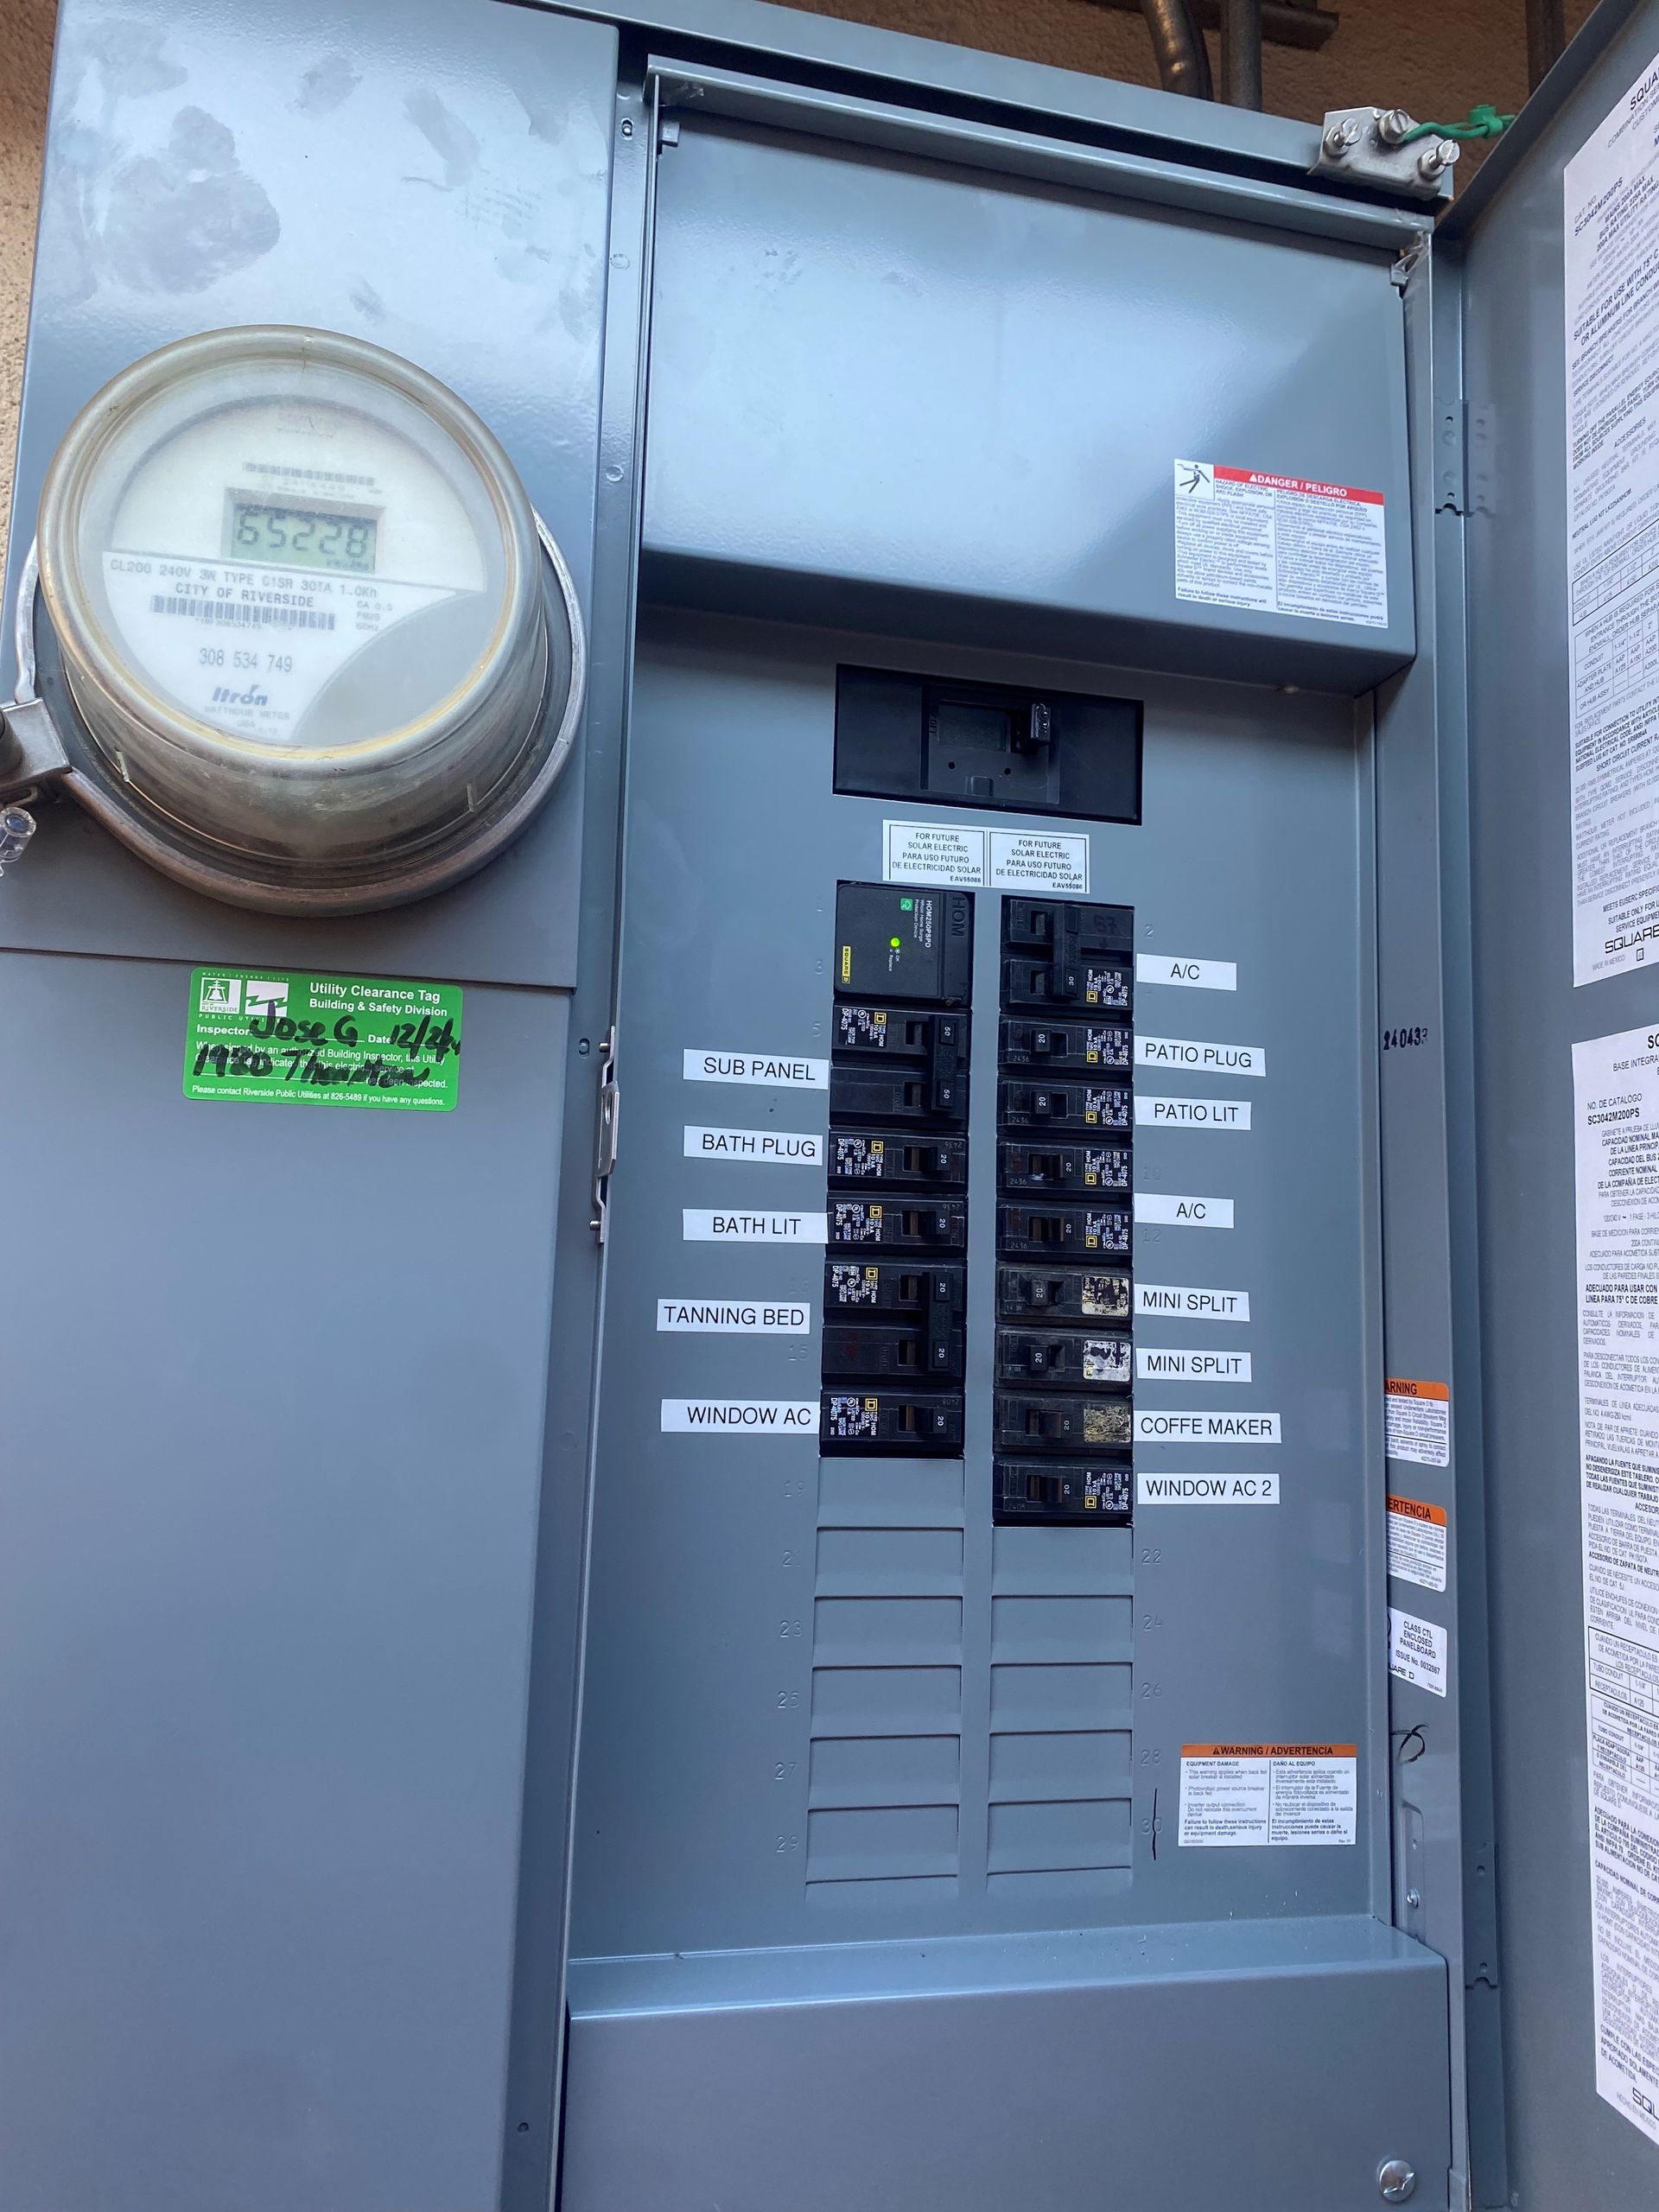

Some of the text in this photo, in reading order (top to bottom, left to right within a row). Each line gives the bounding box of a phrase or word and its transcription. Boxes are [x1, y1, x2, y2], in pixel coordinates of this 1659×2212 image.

[1257, 474, 1298, 489] DANGER
[1306, 483, 1347, 496] PELIGRO
[237, 509, 369, 558] 65228
[160, 565, 192, 579] 240V
[224, 571, 254, 586] TYPE
[175, 582, 315, 607] CITY OF RIVERSIDE
[199, 648, 292, 673] 308 534 749
[932, 834, 959, 842] FUTURE
[1035, 841, 1061, 849] FUTURE
[907, 842, 969, 852] SOLAR ELECTRIC
[1037, 849, 1070, 859] ELECTRIC
[902, 852, 922, 861] PARA
[941, 855, 969, 863] FUTURO
[1044, 861, 1071, 870] FUTURO
[904, 862, 956, 872] ELECTRICIDAD
[1007, 868, 1057, 879] ELECTRICIDAD
[1059, 873, 1083, 881] SOLAR
[1605, 924, 1659, 954] SQUARE
[1170, 963, 1201, 981] A/C
[310, 982, 441, 1003] Utility Clearance Tag
[309, 998, 448, 1017] Building & Safety Division
[1039, 1033, 1046, 1044] 20
[327, 1049, 361, 1060] Building
[1145, 1043, 1252, 1068] PATIO PLUG
[703, 1056, 816, 1081] SUB PANEL
[1613, 1060, 1630, 1071] BASE
[193, 1085, 215, 1094] Please
[331, 1092, 362, 1101] 826-5489
[363, 1093, 368, 1102] if
[369, 1095, 380, 1103] you
[382, 1094, 398, 1103] have
[413, 1097, 445, 1106] questions.
[1039, 1096, 1046, 1107] 20
[1599, 1099, 1607, 1109] DE
[1609, 1093, 1642, 1107] CATALOGO
[1154, 1102, 1239, 1122] PATIO LIT
[1587, 1108, 1640, 1125] SC3042M200PS
[702, 1133, 816, 1158] BATH PLUG
[940, 1154, 947, 1164] 20
[1065, 1162, 1072, 1172] 20
[1176, 1202, 1207, 1220] A/C
[713, 1217, 802, 1236] BATH LIT
[939, 1218, 945, 1229] 20
[1065, 1224, 1072, 1234] 20
[939, 1282, 946, 1293] 20
[1036, 1287, 1044, 1299] 20
[1142, 1291, 1181, 1310] MINI
[1187, 1294, 1237, 1313] SPLIT
[664, 1306, 804, 1326] TANNING BED
[938, 1348, 945, 1358] 20
[1035, 1352, 1043, 1363] 20
[1147, 1355, 1185, 1373] MINI
[1192, 1357, 1243, 1375] SPLIT
[1384, 1381, 1417, 1395] ARNING
[687, 1406, 811, 1426] WINDOW AC
[937, 1415, 944, 1426] 20
[1064, 1420, 1070, 1430] 20
[1141, 1416, 1203, 1435] COFFE
[1208, 1418, 1272, 1435] MAKER
[1064, 1484, 1070, 1495] 20
[1146, 1478, 1272, 1497] WINDOW AC 2
[1403, 1621, 1433, 1639] CLASS CTL
[1404, 1630, 1433, 1648] ENCLOSED
[1395, 1649, 1410, 1662] ISSUE
[1400, 1637, 1436, 1659] PANELBOARD
[1270, 1746, 1333, 1755] ADVERTENCIA
